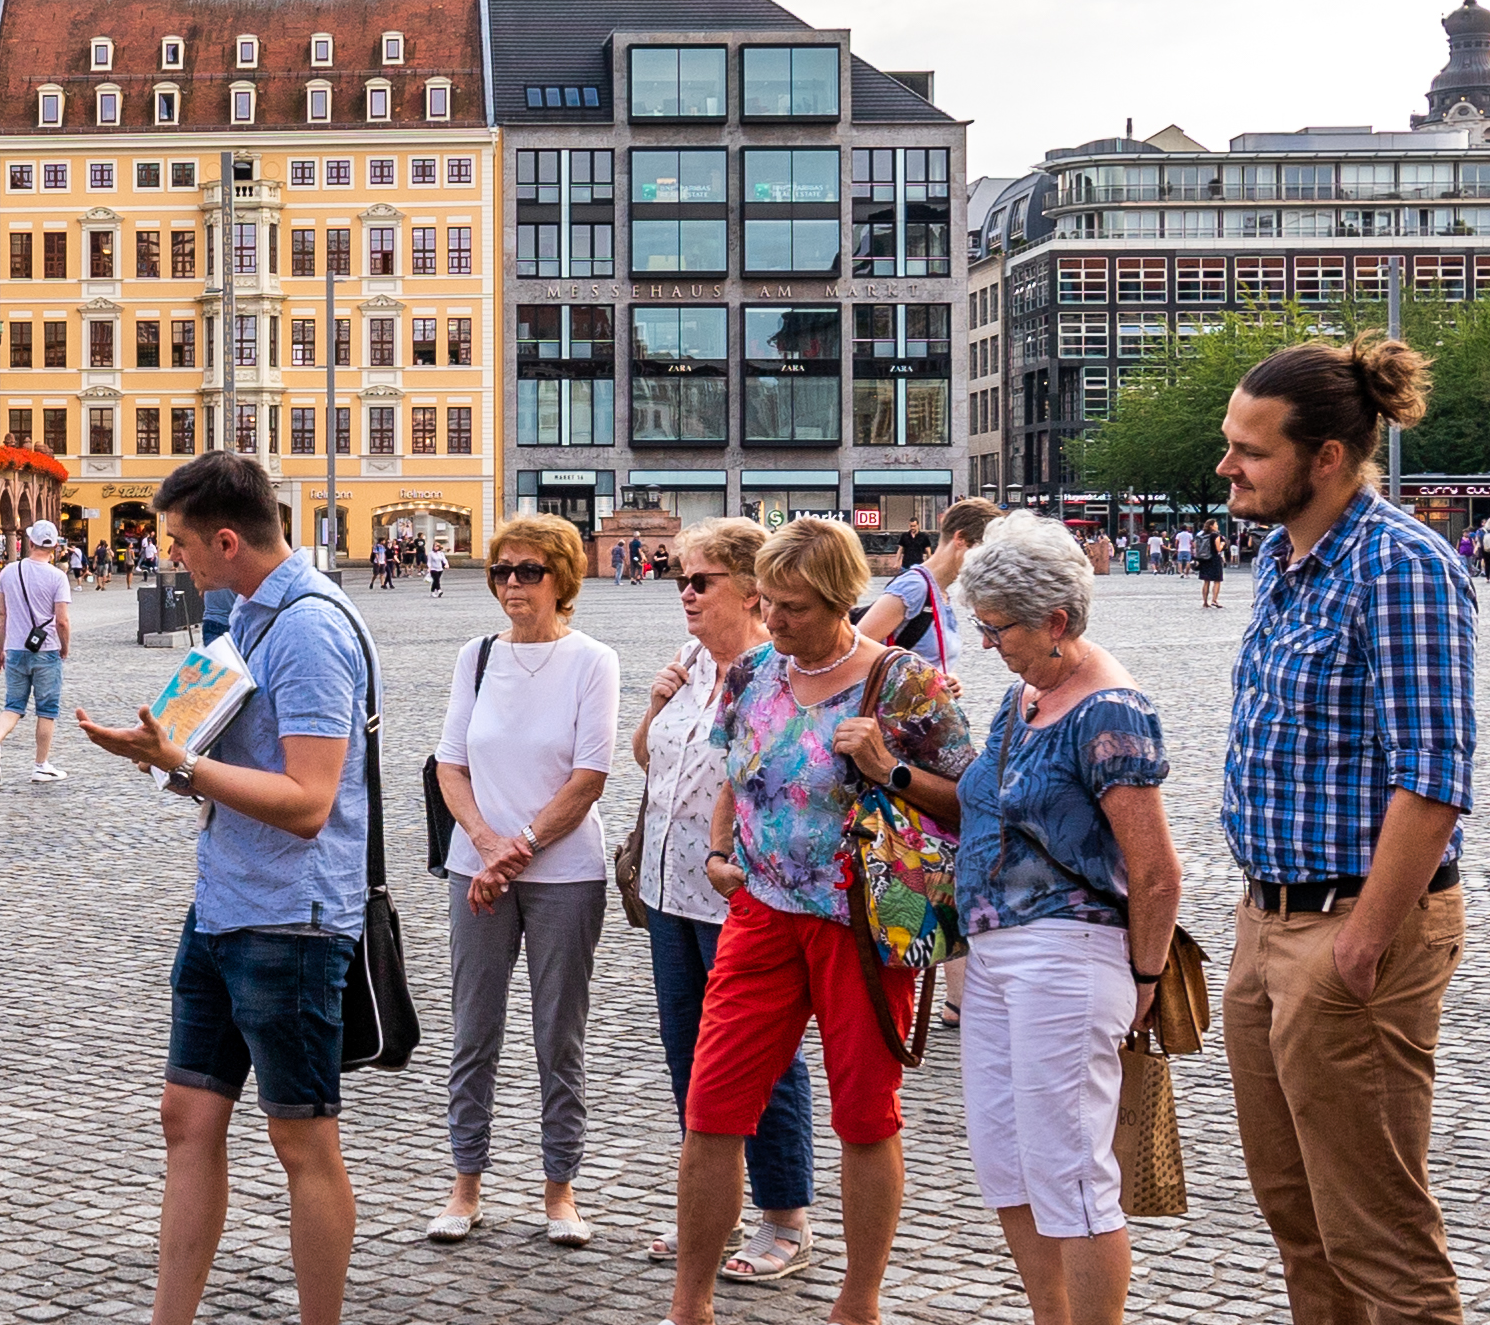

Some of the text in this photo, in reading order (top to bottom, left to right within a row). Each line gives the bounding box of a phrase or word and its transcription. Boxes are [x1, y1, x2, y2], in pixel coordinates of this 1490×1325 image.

[546, 284, 920, 298] MESSEHAUS AM MARKT
[224, 391, 234, 449] MUSEUM
[859, 512, 877, 524] DB
